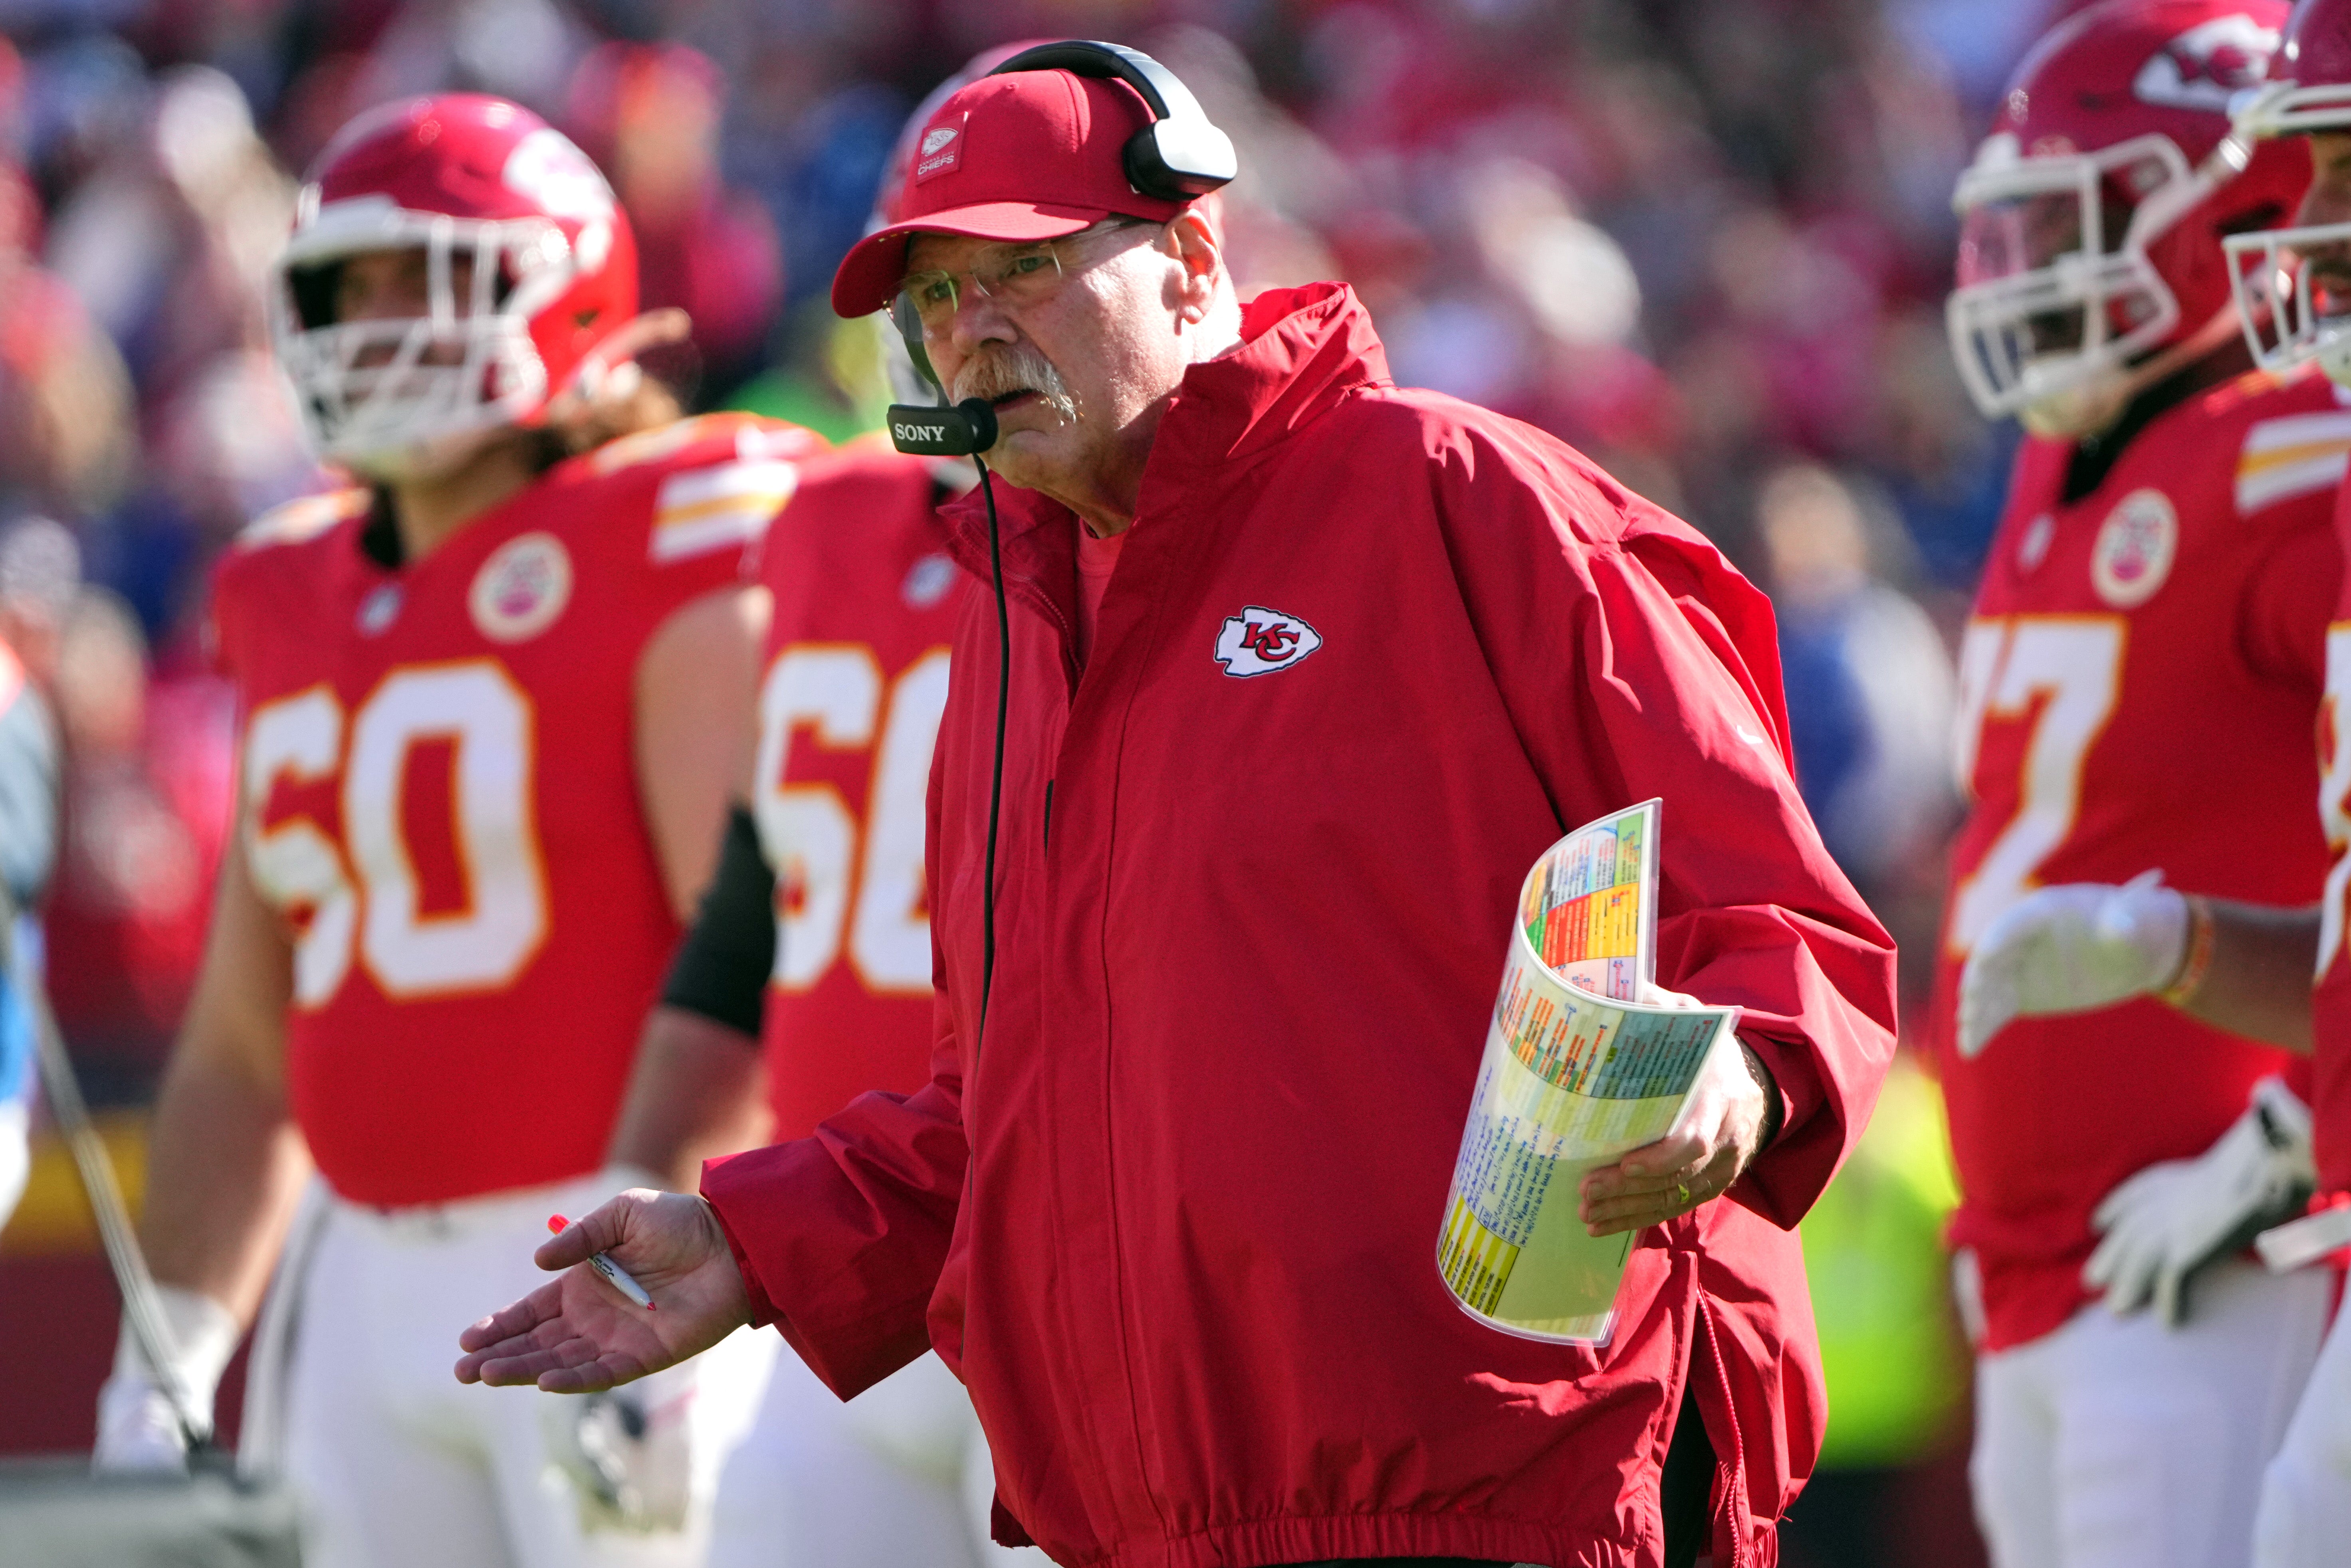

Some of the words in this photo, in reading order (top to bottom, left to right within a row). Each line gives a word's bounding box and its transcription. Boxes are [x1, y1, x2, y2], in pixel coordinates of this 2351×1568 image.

[918, 155, 954, 175] CHIEFS
[895, 423, 945, 441] SONY
[1239, 622, 1300, 662] KC
